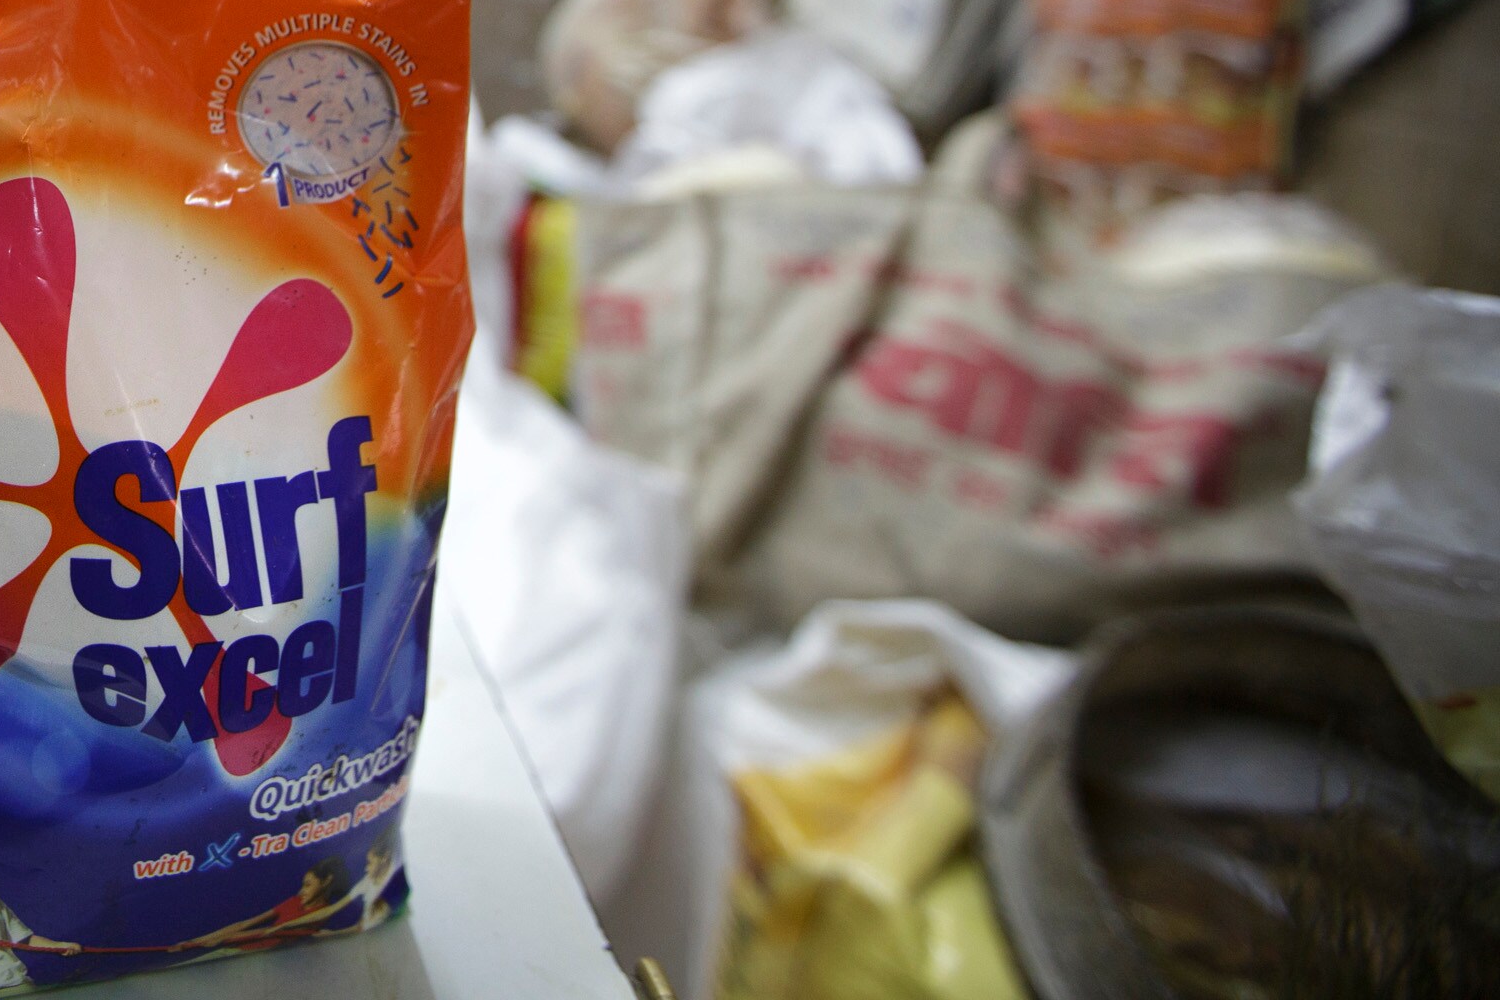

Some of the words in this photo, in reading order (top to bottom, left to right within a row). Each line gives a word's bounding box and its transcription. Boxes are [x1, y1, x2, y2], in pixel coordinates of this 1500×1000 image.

[208, 41, 256, 135] REMOVES
[254, 13, 355, 47] MULTIPLE
[357, 23, 417, 76] STAINS
[408, 83, 429, 107] IN
[263, 161, 290, 208] 1
[293, 166, 370, 199] PRODUCT
[70, 416, 379, 621] Surf
[73, 584, 362, 743] excel
[250, 714, 420, 821] Quickwash
[134, 851, 195, 879] with
[292, 811, 350, 848] Clean
